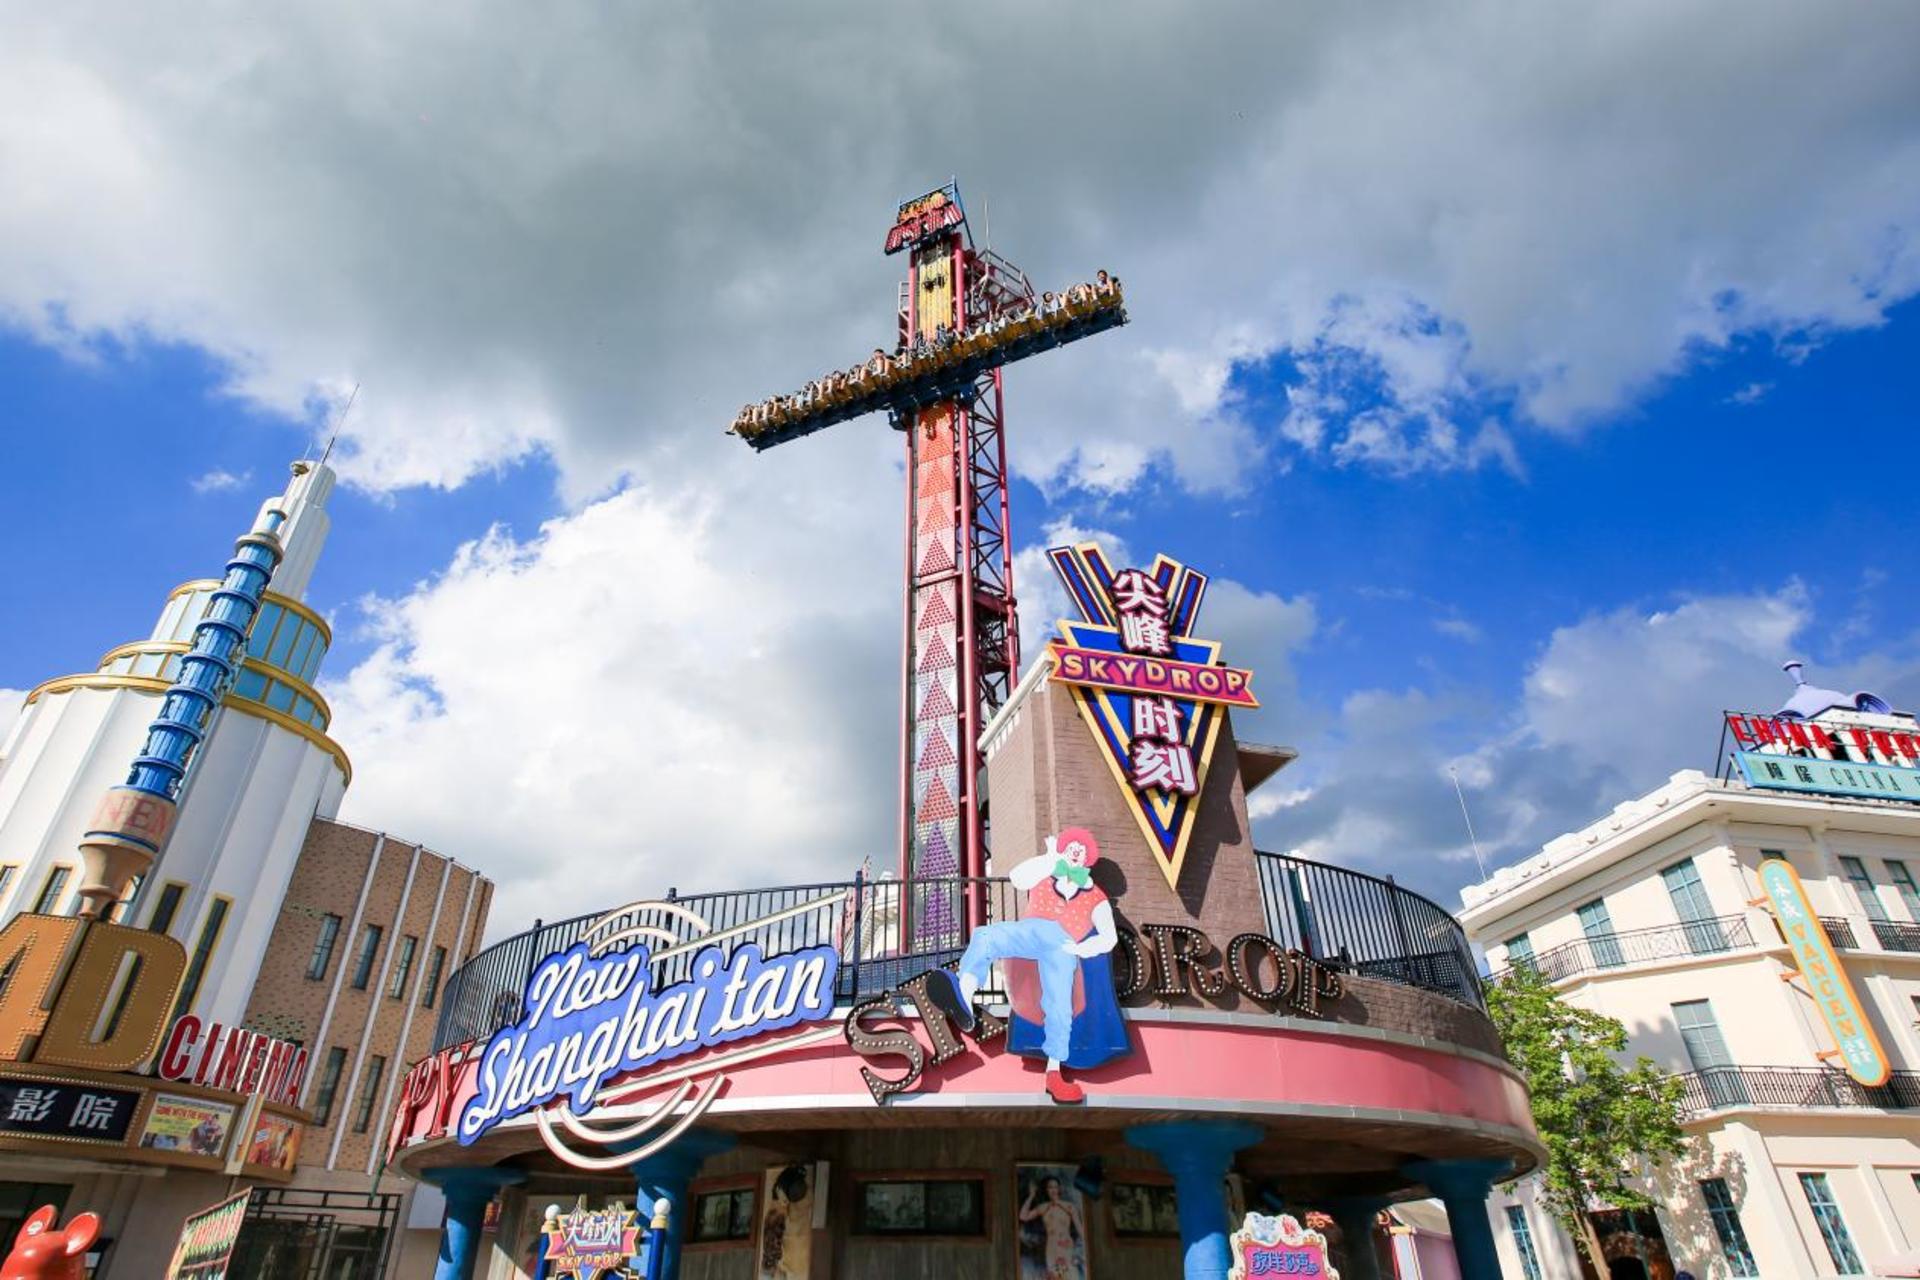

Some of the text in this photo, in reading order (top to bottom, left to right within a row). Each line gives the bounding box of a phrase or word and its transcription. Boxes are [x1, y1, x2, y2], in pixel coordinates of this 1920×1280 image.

[1111, 569, 1173, 655] 尖峰
[1062, 653, 1247, 695] SKYDROP
[1131, 695, 1199, 796] 时刻
[1727, 716, 1833, 749] CHINA
[1830, 767, 1902, 791] CHINA
[531, 951, 640, 1029] New
[160, 1015, 308, 1108] CINEMA
[7, 1086, 119, 1131] 影院
